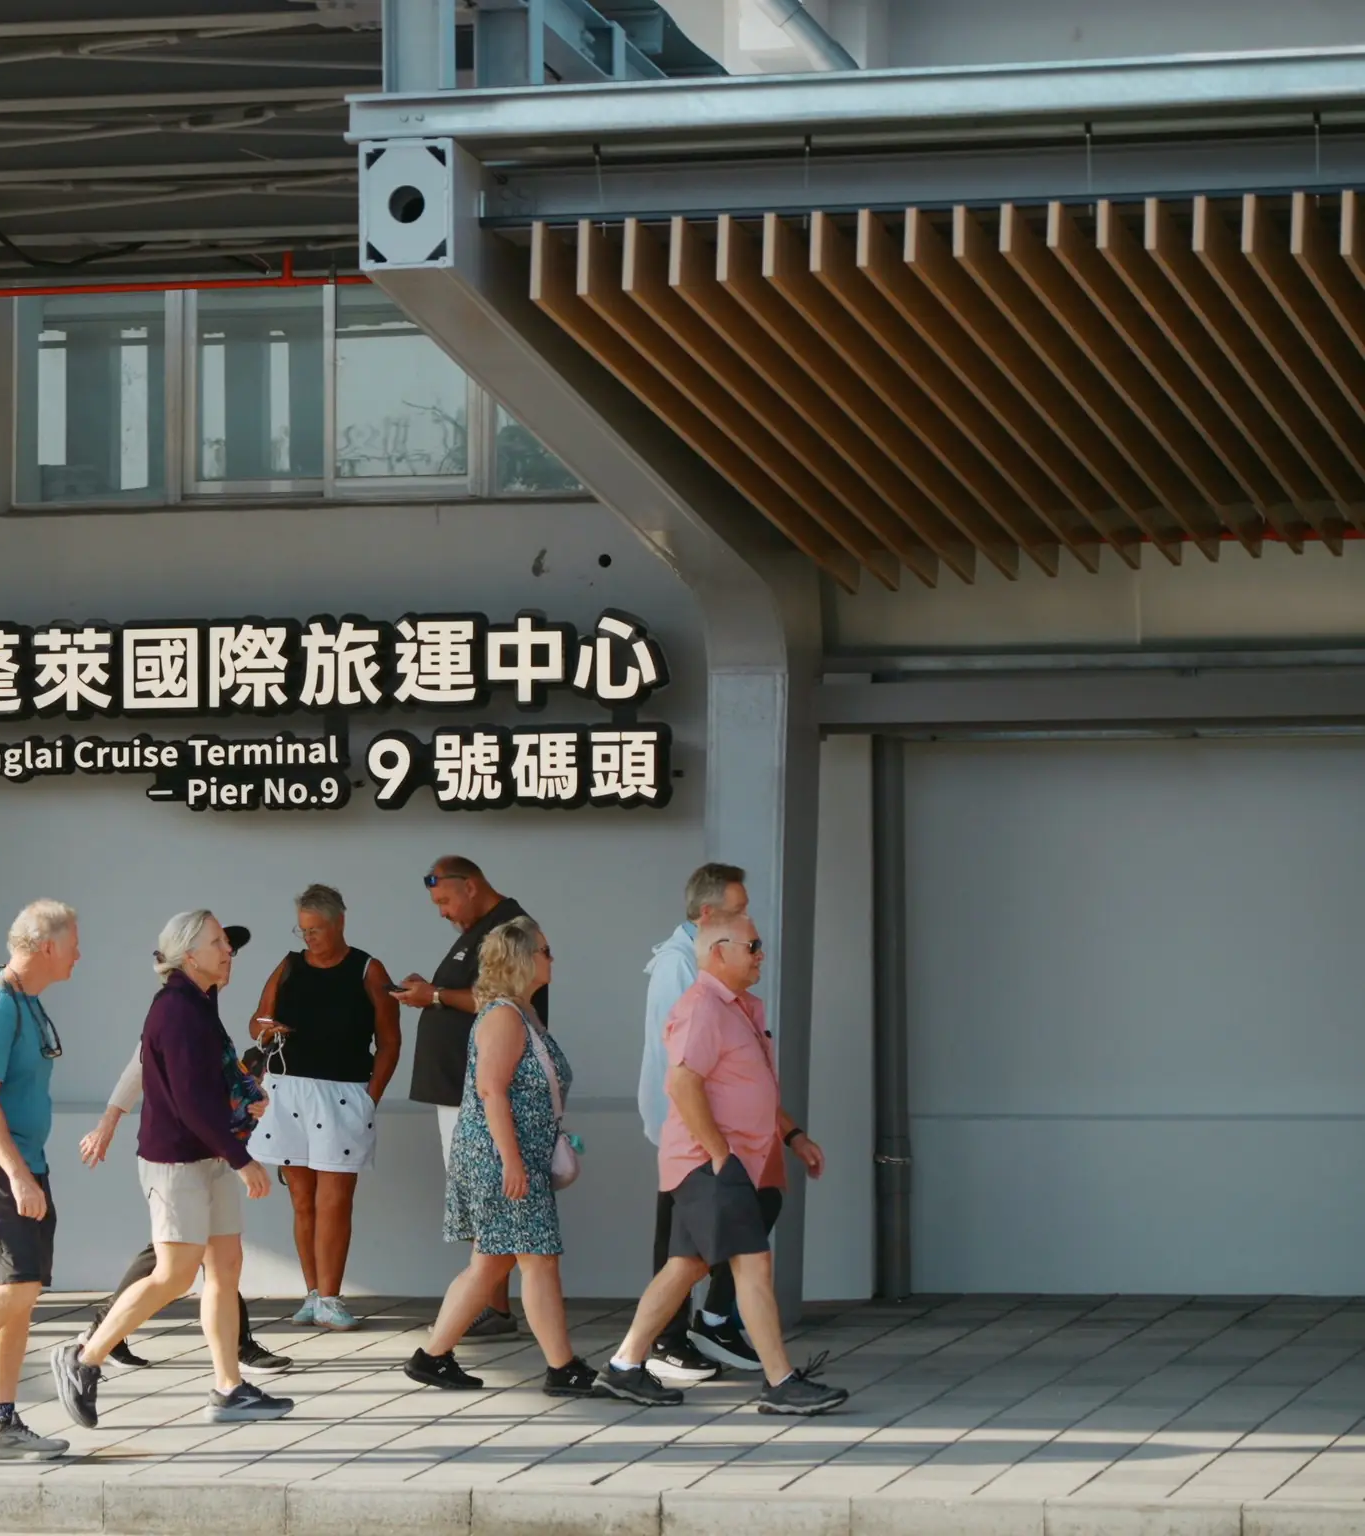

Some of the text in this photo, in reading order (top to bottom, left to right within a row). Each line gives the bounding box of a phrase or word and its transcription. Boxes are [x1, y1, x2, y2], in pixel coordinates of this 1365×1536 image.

[74, 739, 178, 768] Cruise
[188, 735, 339, 766] Terminal
[188, 776, 254, 805] Pier
[264, 777, 339, 804] No.9
